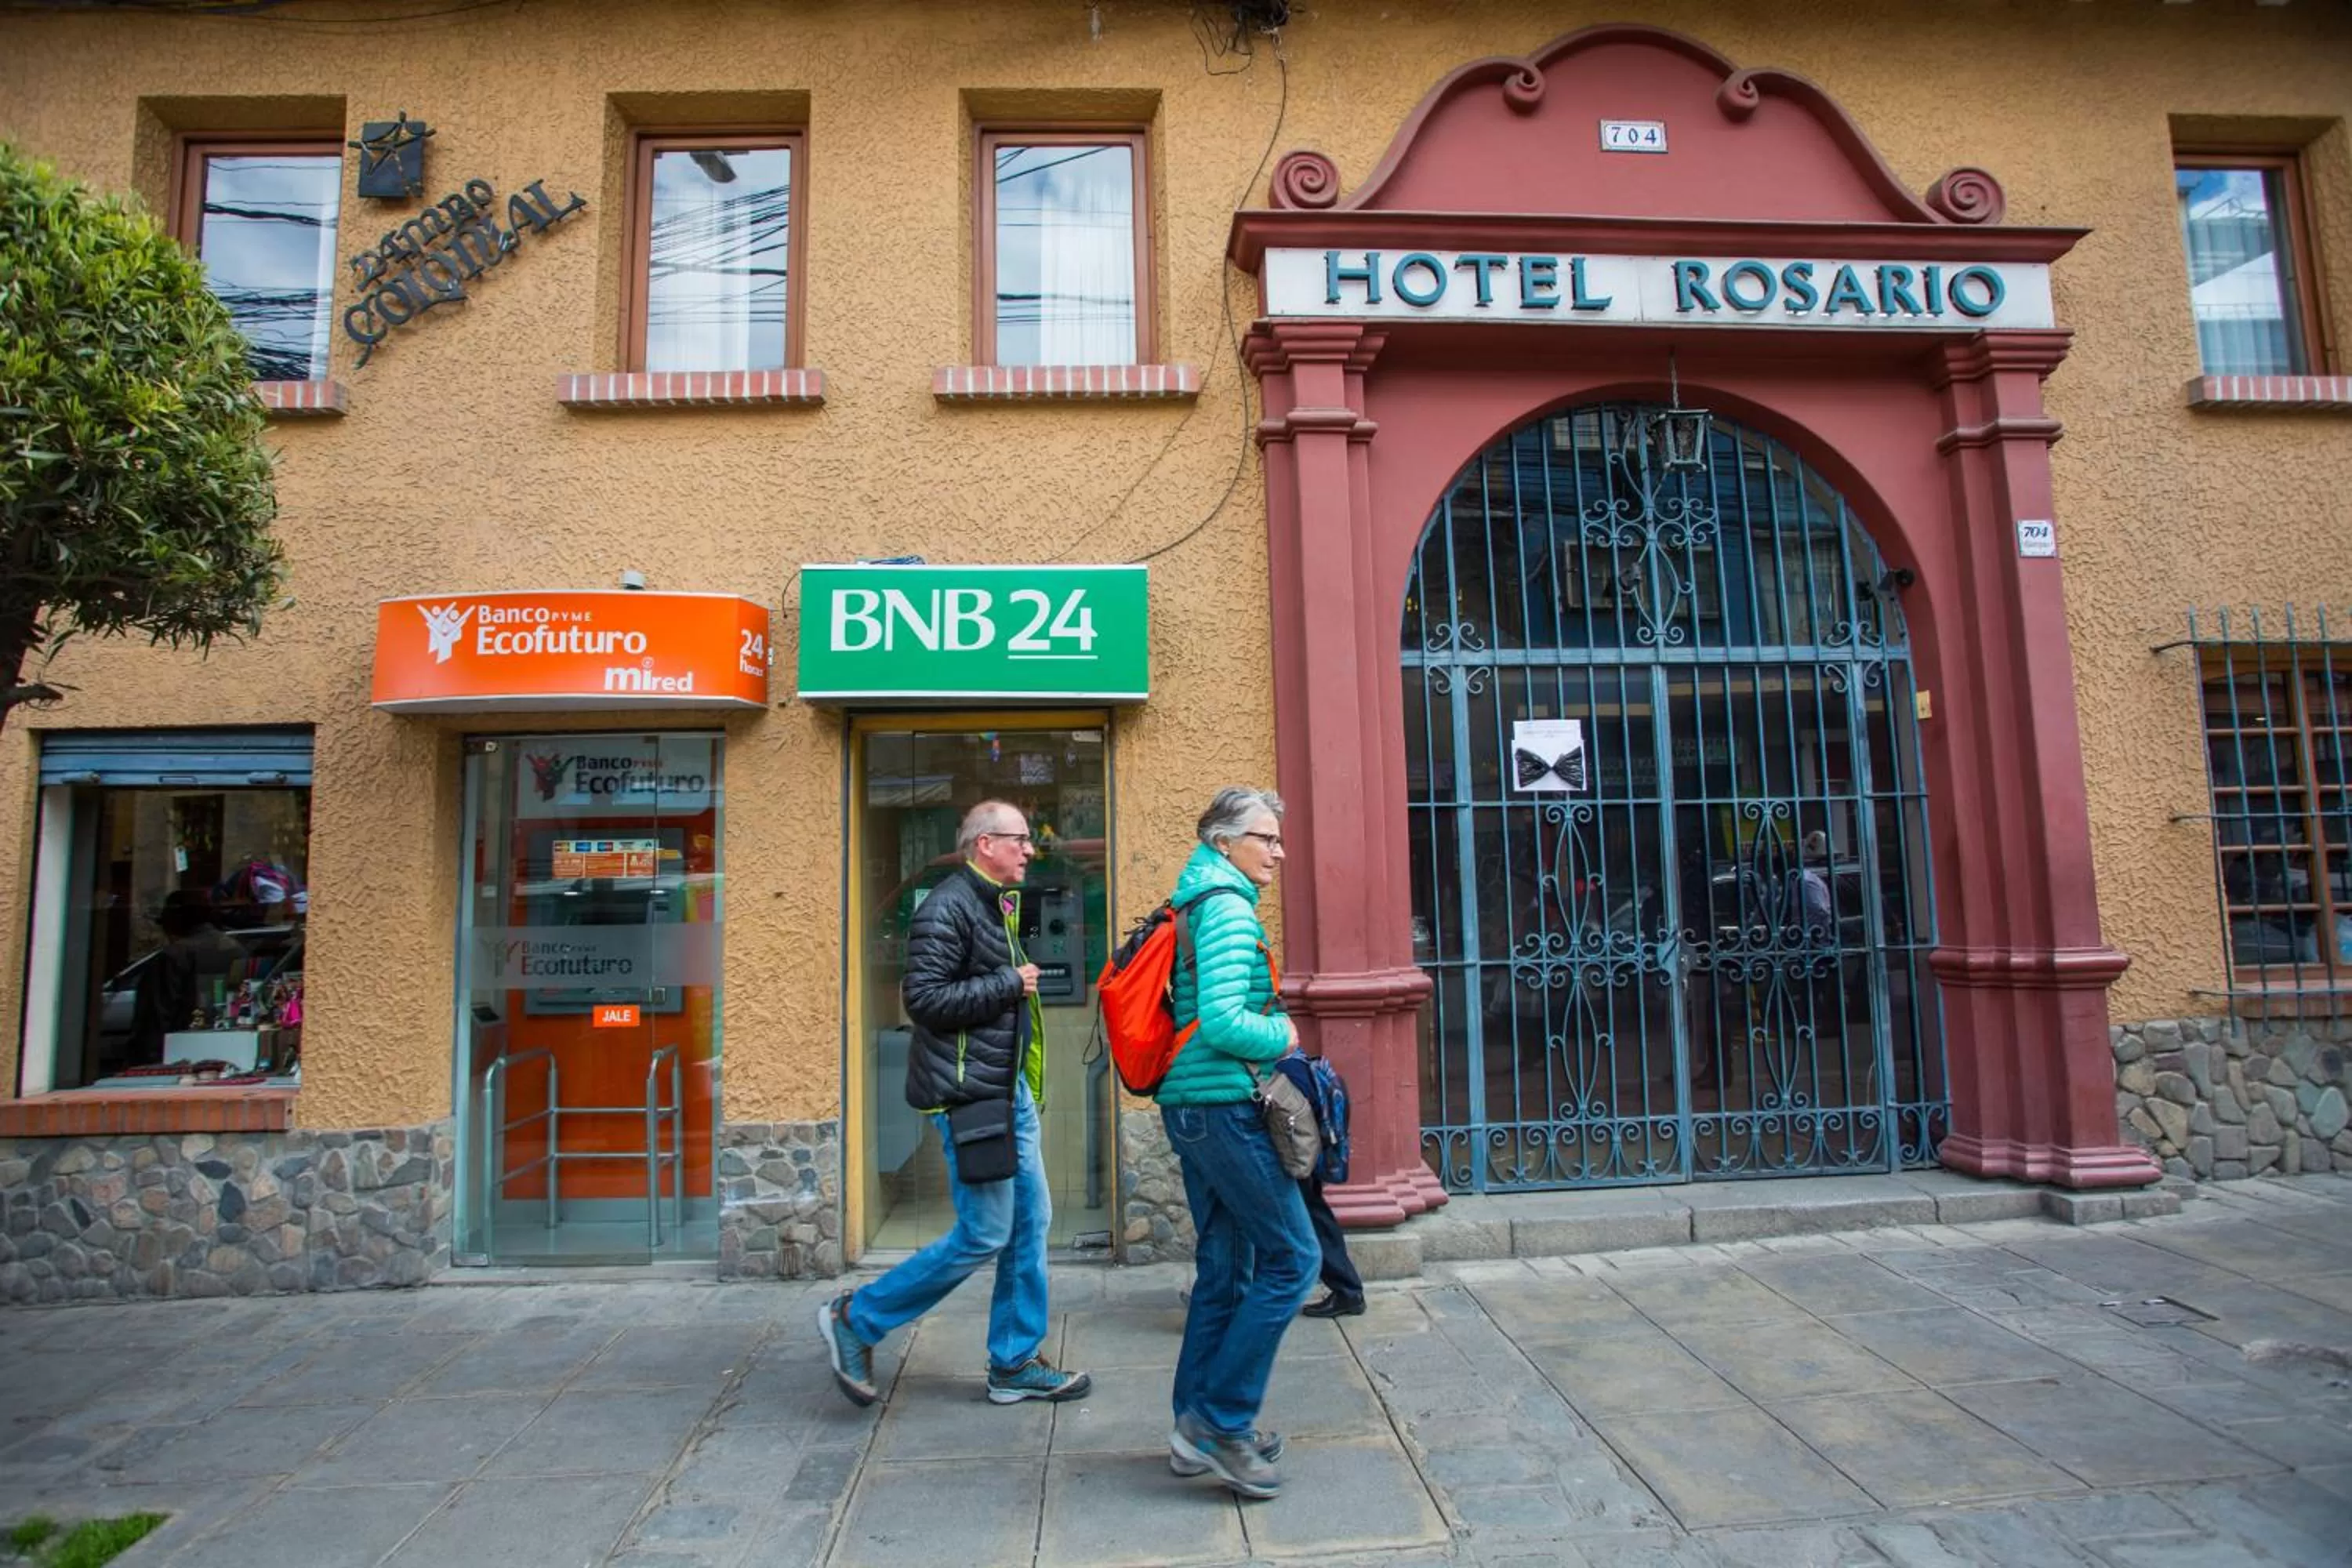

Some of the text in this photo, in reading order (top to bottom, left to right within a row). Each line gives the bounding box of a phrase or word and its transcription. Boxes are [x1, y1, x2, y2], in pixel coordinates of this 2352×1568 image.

[1611, 126, 1657, 144] 704
[1323, 250, 2007, 318] HOTEL ROSARIO
[2024, 526, 2049, 538] 704
[477, 604, 593, 624] Banco PYME
[830, 589, 1098, 652] BNB 24
[476, 623, 648, 655] Ecofuturo
[740, 629, 764, 659] 24
[575, 755, 633, 770] Banco
[575, 771, 705, 794] Ecofuturo
[521, 954, 633, 975] Ecofuturo
[601, 1009, 632, 1022] JALE
